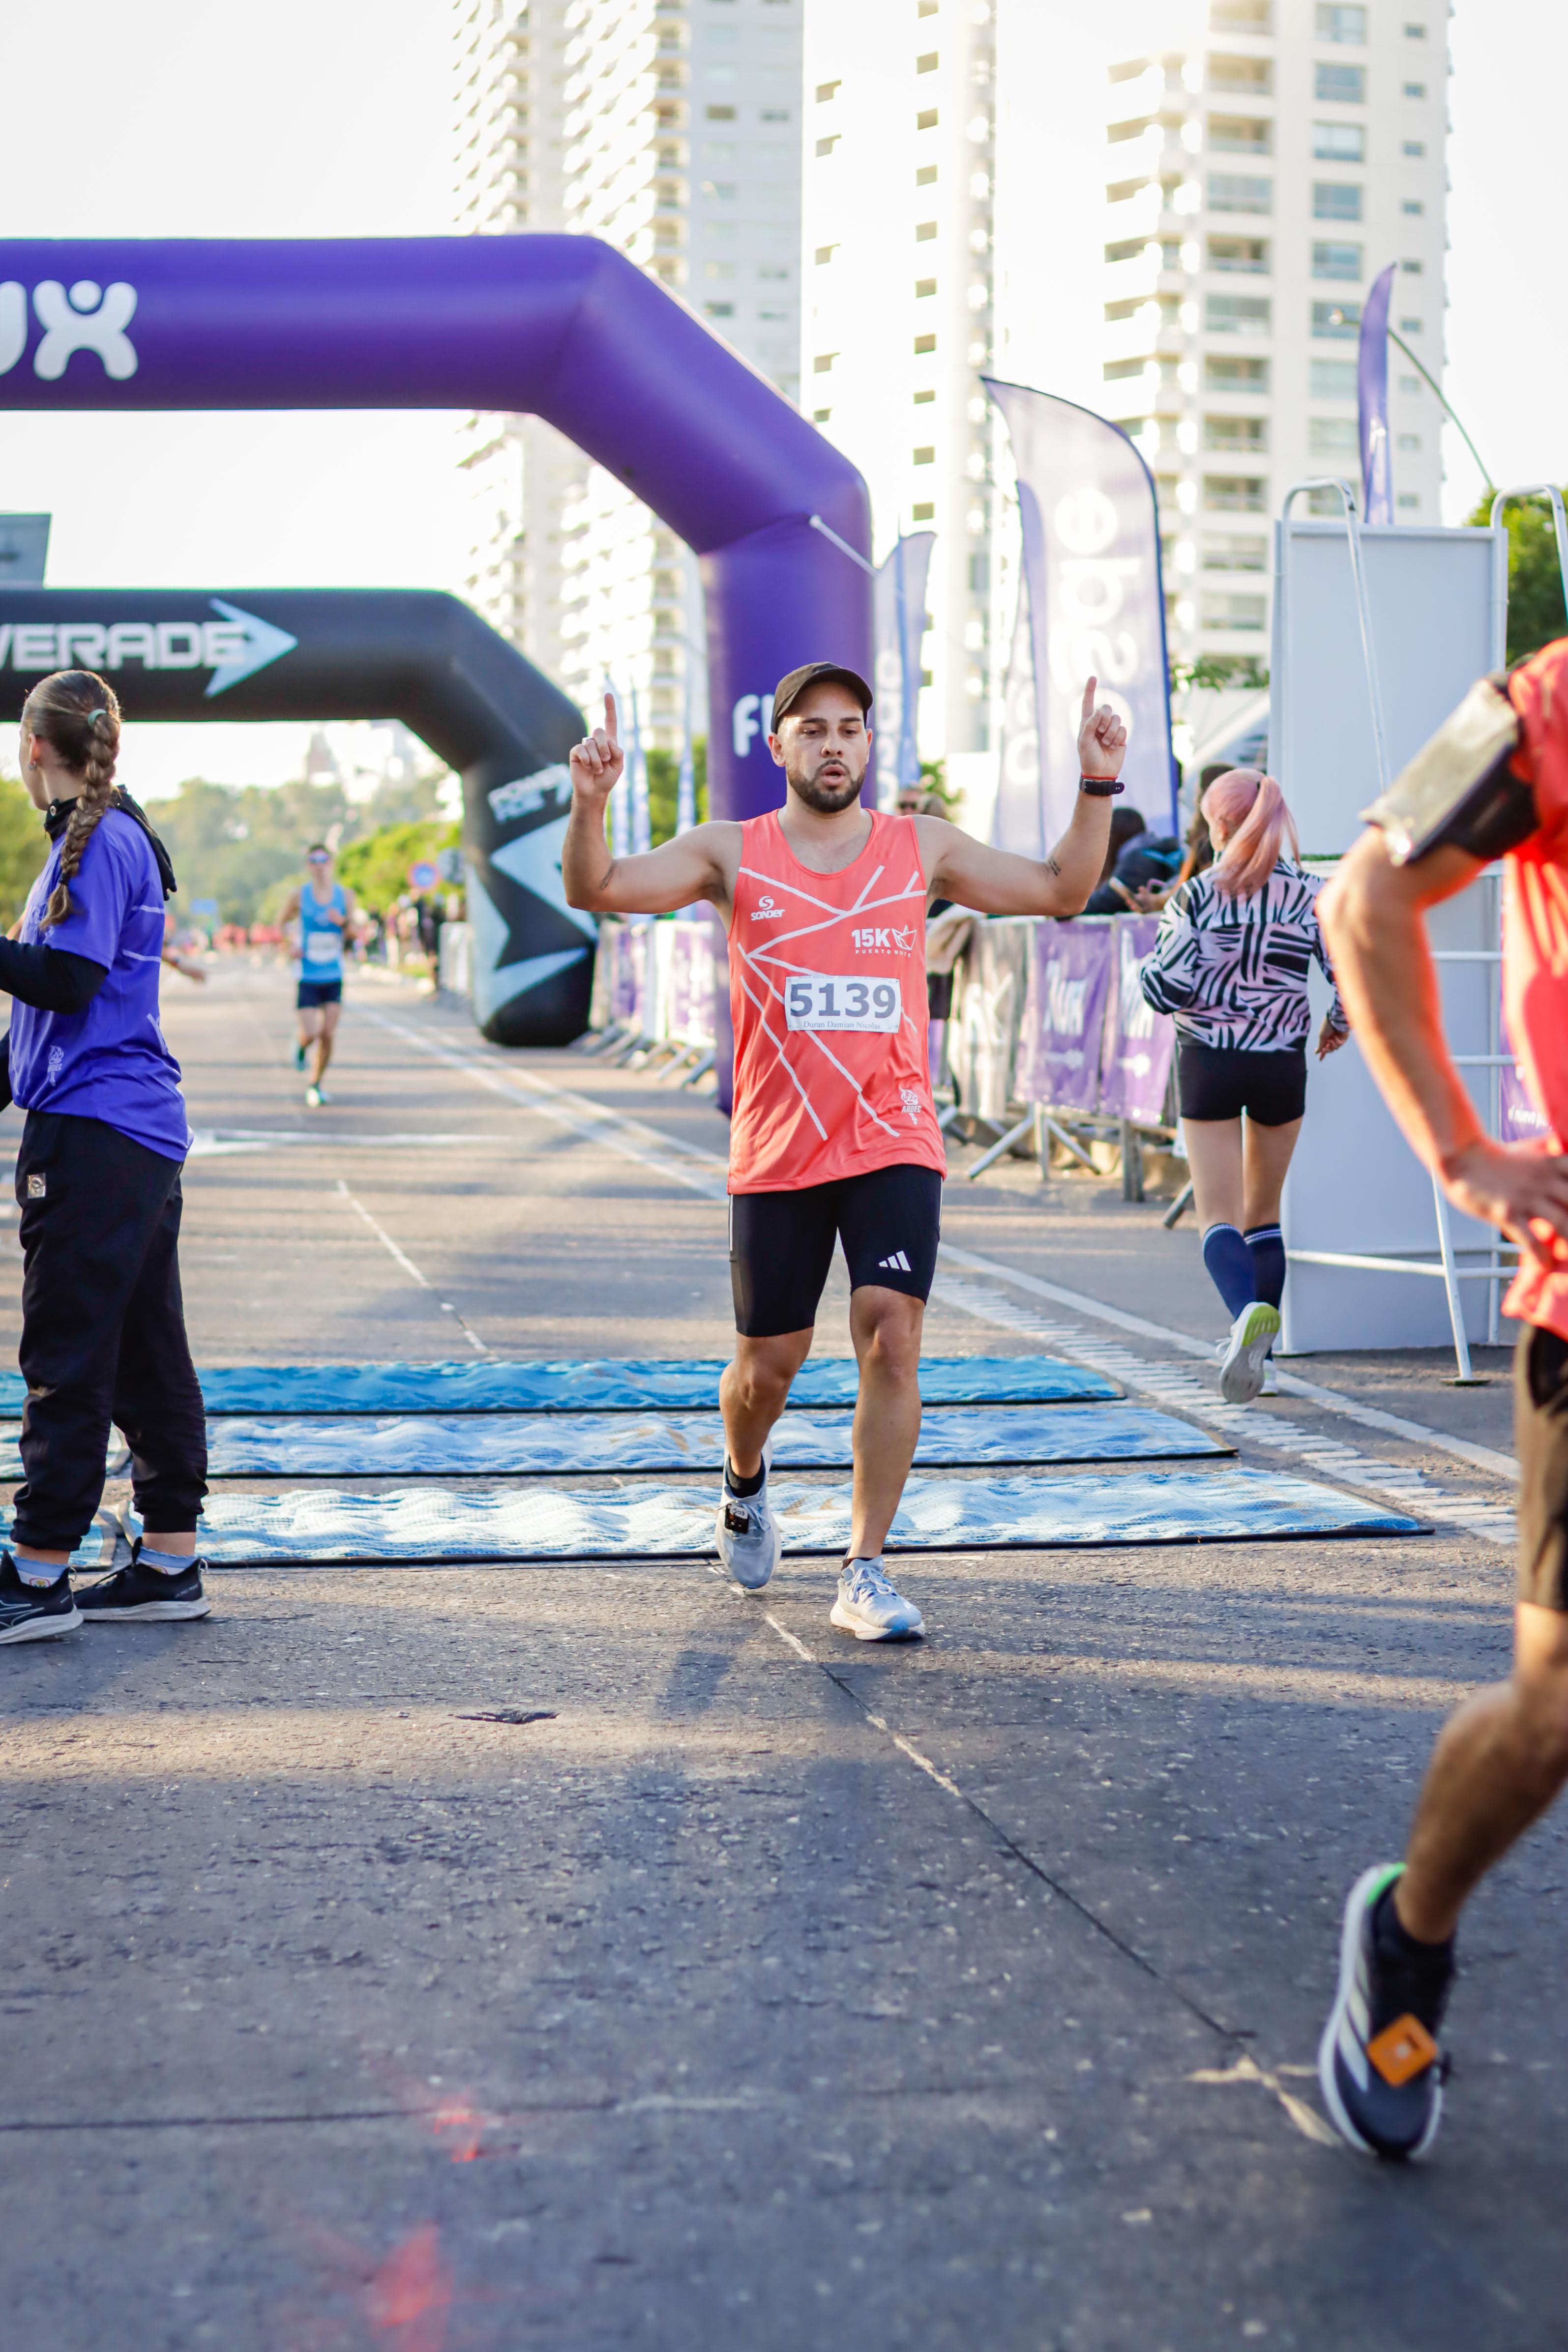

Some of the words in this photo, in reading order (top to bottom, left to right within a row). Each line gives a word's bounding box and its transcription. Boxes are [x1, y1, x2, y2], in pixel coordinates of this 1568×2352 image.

[851, 928, 891, 948] 15K
[790, 983, 896, 1019] 5139
[856, 1021, 881, 1029] Nicolas
[901, 1105, 921, 1113] ARDEC
